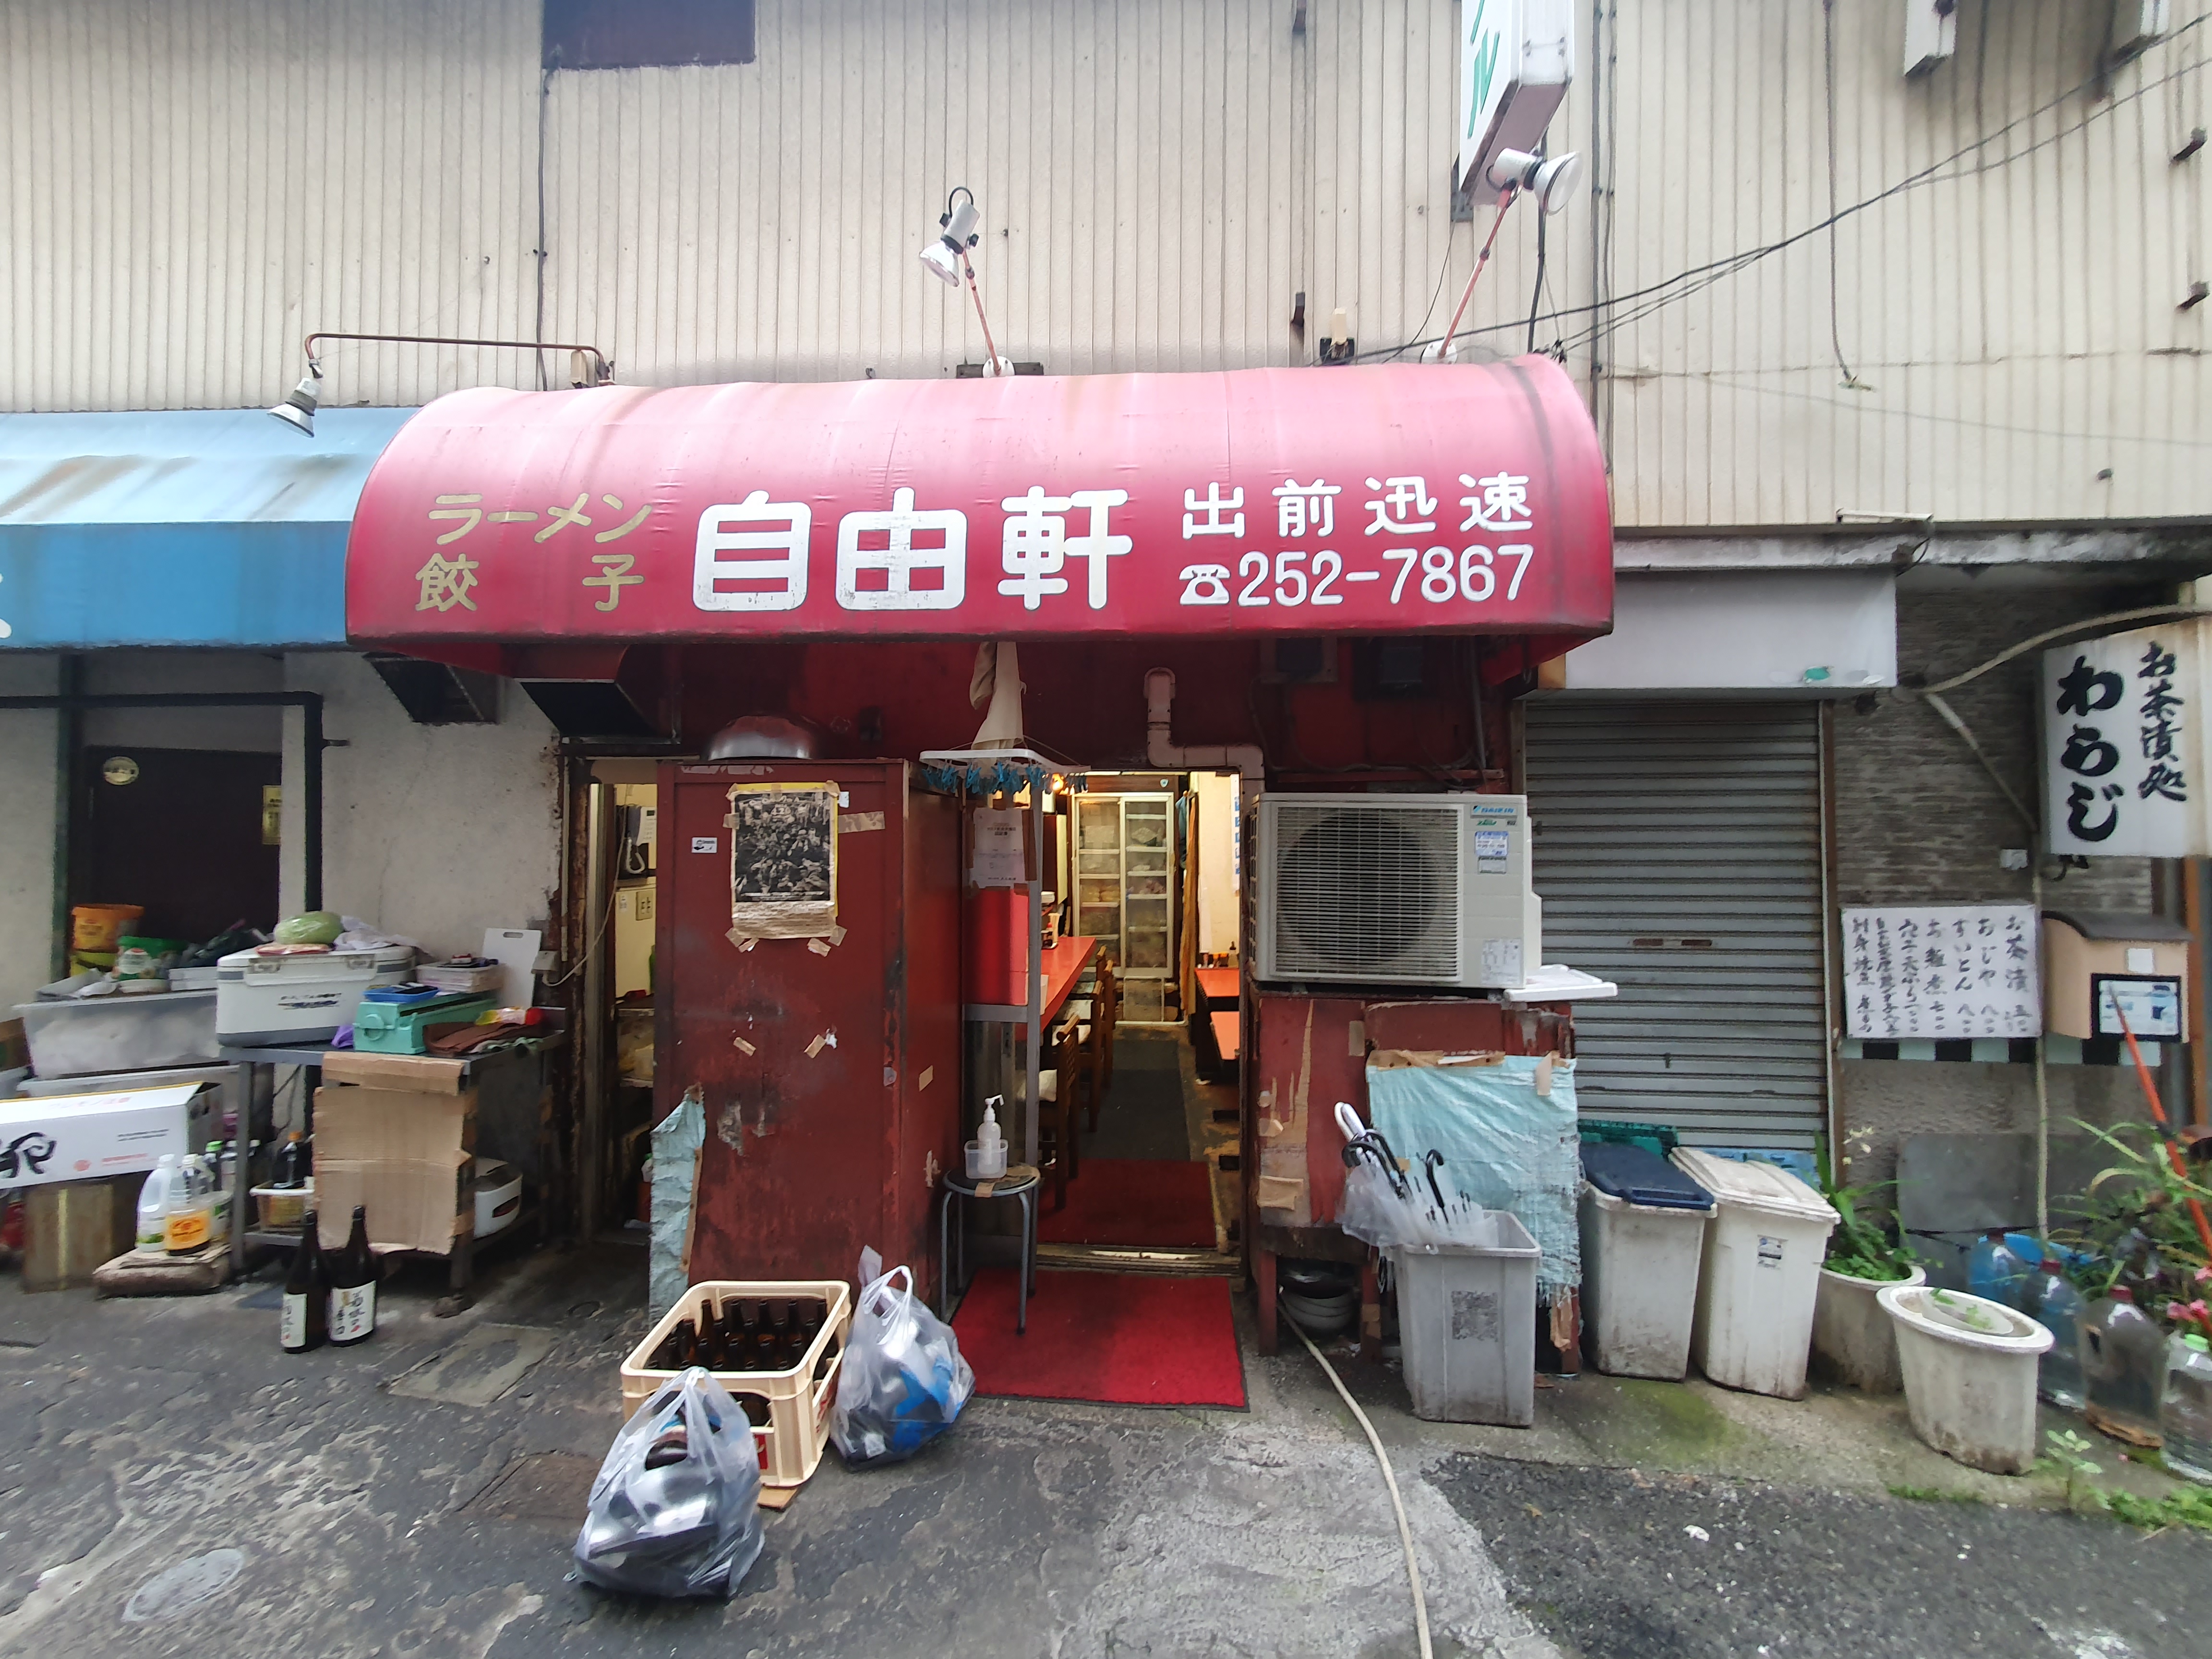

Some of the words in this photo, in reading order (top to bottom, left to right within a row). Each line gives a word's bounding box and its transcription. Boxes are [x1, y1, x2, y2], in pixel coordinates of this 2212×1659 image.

[427, 493, 653, 545] ラーメン
[1182, 471, 1534, 540] 出前迅速
[692, 485, 1133, 612] 自由軒
[1238, 543, 1535, 607] 252-7867
[414, 551, 645, 613] 餃子
[2056, 655, 2126, 842] わらじ
